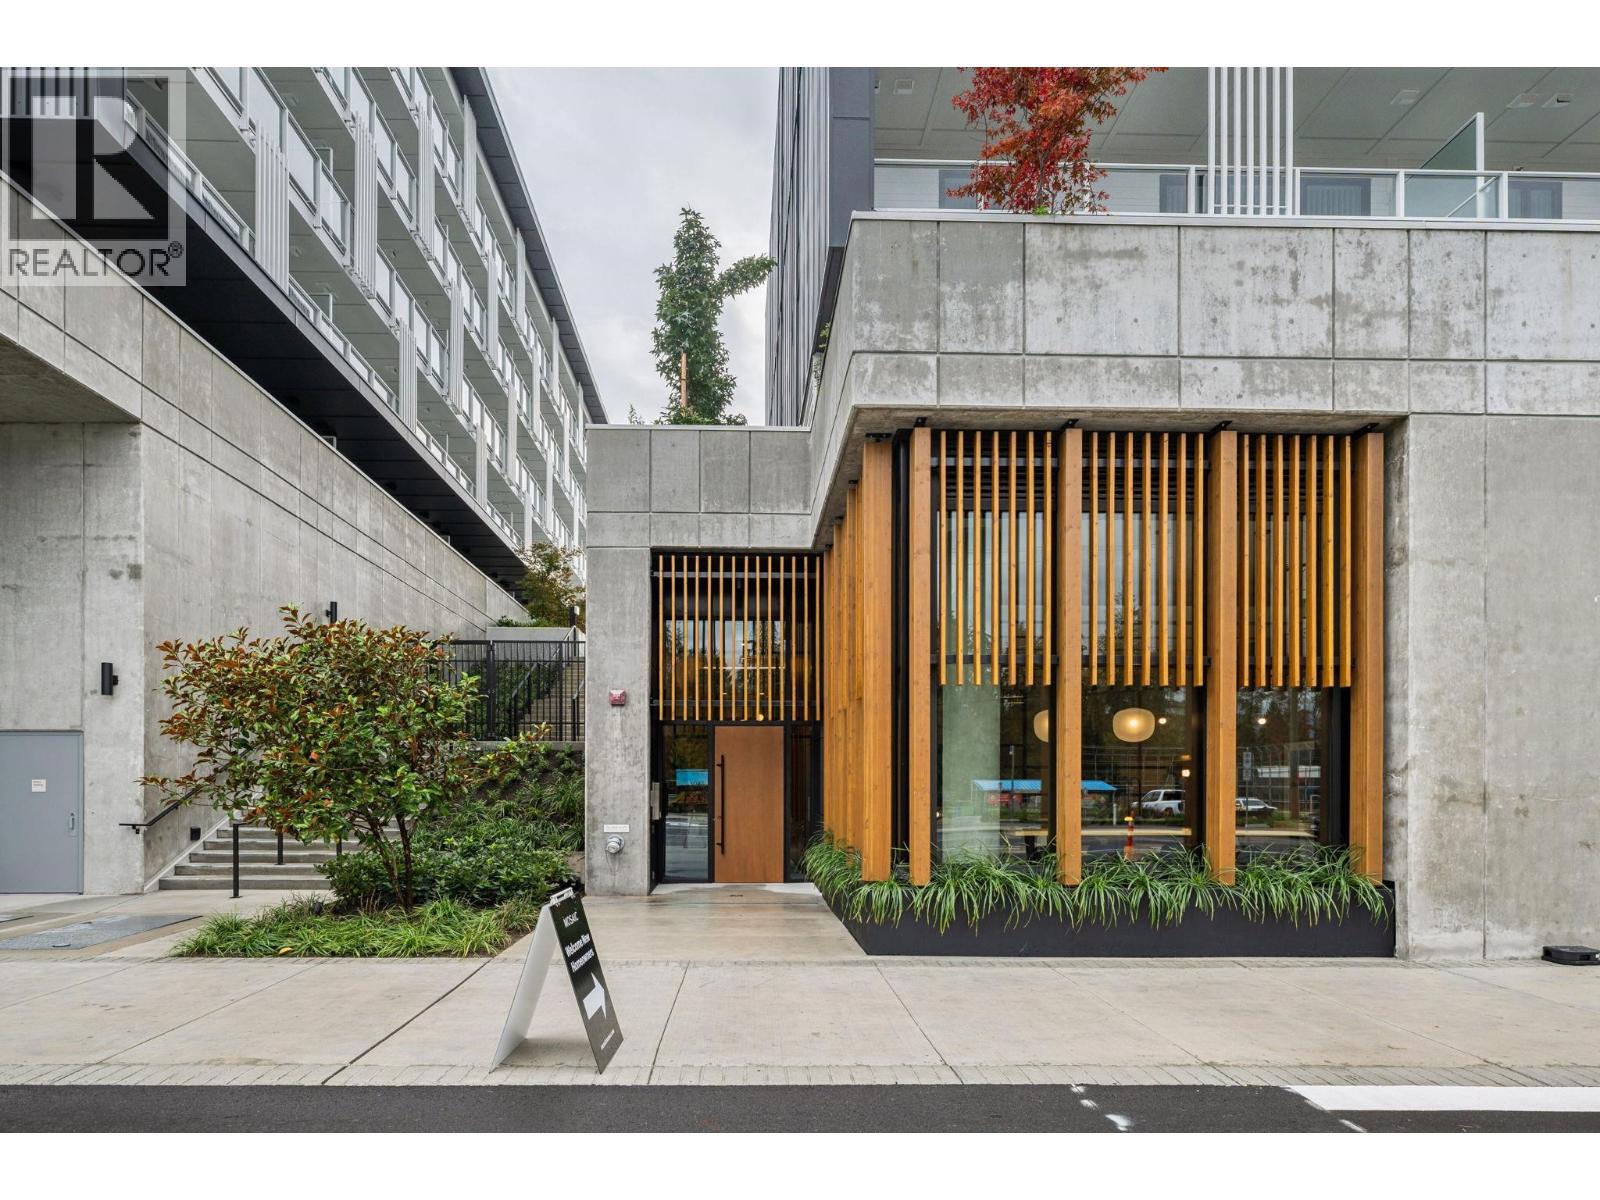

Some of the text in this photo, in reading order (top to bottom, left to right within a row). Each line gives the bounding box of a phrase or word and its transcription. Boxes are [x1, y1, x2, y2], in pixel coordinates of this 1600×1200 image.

[565, 933, 591, 957] Welcome New
[570, 948, 594, 973] Homeowners
